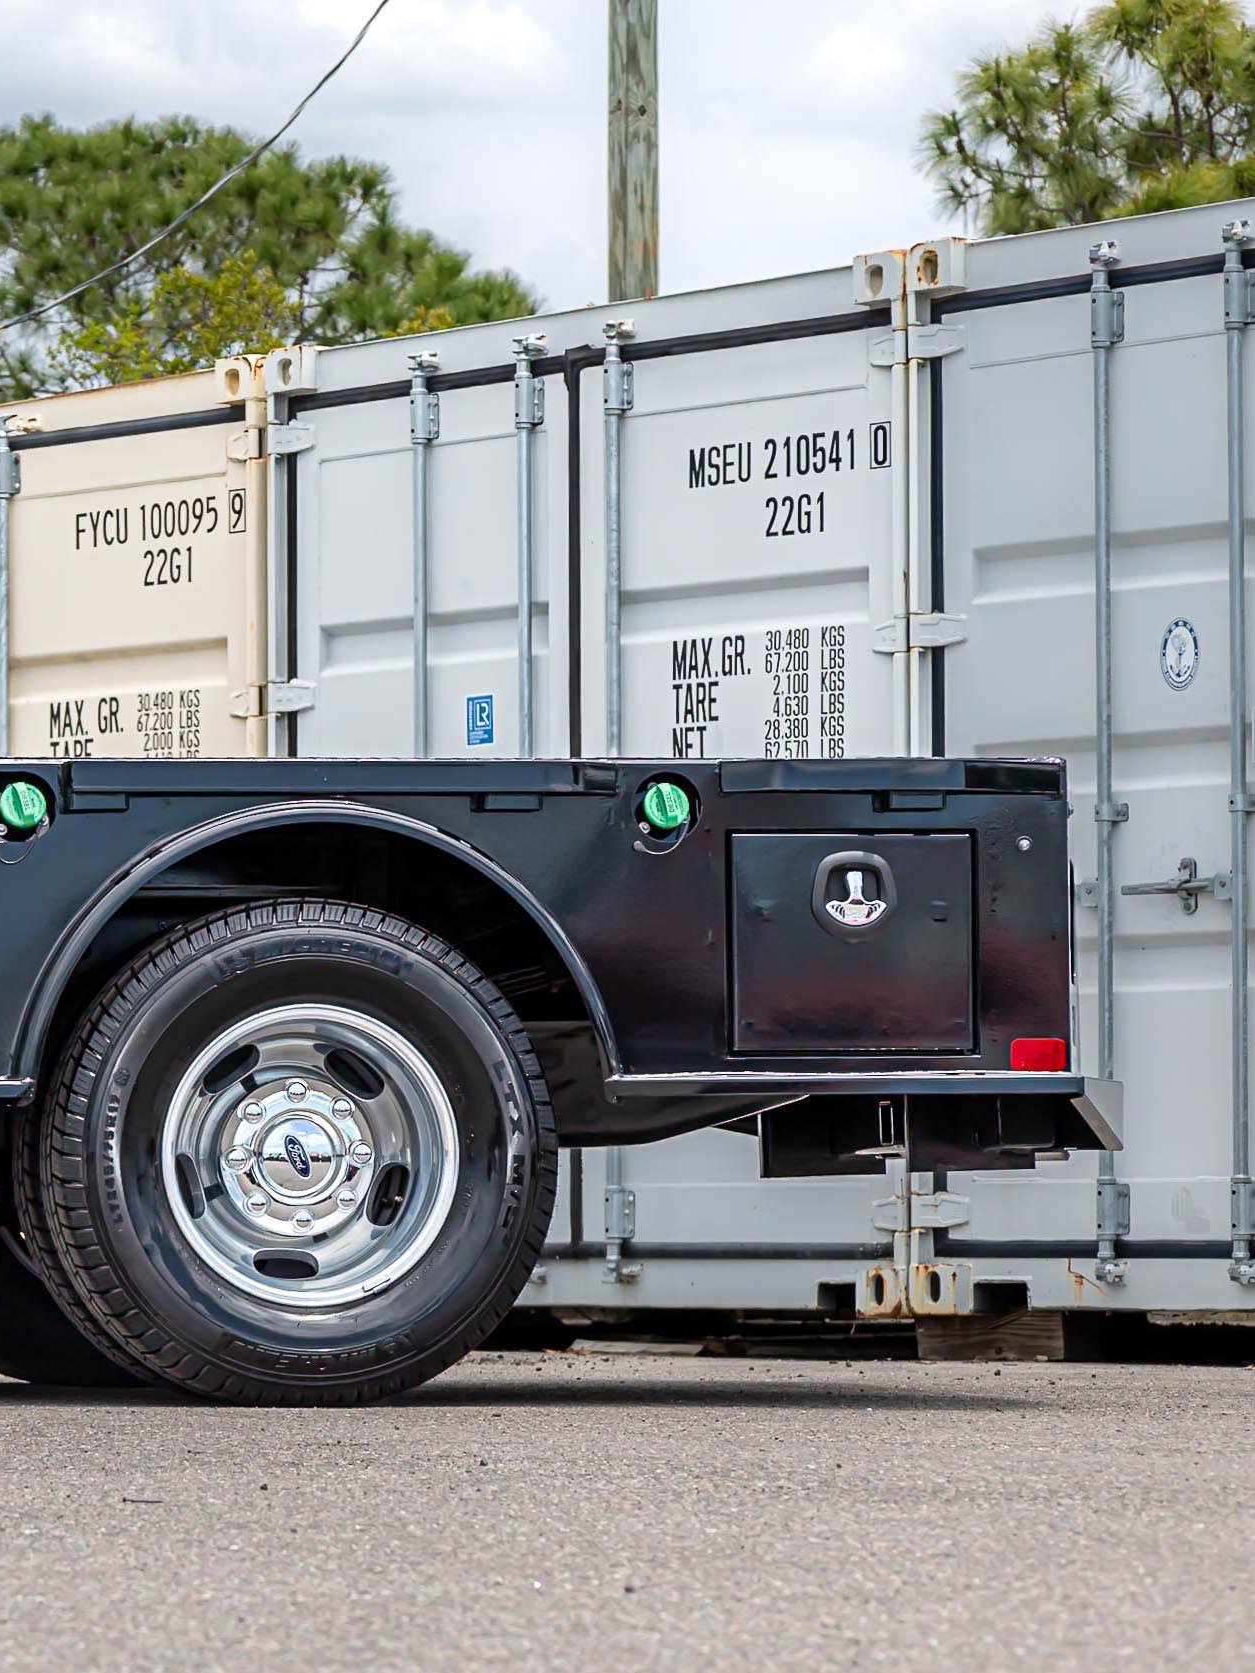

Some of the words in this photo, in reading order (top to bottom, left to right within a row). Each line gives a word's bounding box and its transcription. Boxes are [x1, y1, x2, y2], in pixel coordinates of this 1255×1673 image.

[689, 441, 752, 489] MSEU
[764, 428, 855, 480] 210541
[873, 424, 888, 466] 0
[76, 506, 128, 550] FYCU
[139, 496, 218, 541] 100095
[231, 492, 244, 529] 9
[764, 491, 825, 537] 22G1
[143, 546, 193, 587] 22G1
[765, 628, 809, 651] 30.480
[821, 625, 845, 647] KGS
[765, 650, 809, 673] 67.200
[821, 648, 845, 670] LBS
[50, 699, 88, 739] MAX.
[98, 697, 124, 734] GR.
[179, 689, 200, 709] KGS
[672, 681, 719, 725] TARE
[773, 673, 809, 695] 2.100
[821, 671, 845, 692] KGS
[773, 695, 809, 718] 4.630
[821, 693, 845, 715] LBS
[179, 709, 200, 729] LBS
[179, 729, 200, 749] KGS
[672, 726, 707, 759] NET
[764, 717, 809, 740] 28.380
[821, 715, 845, 737] KGS
[821, 738, 845, 759] LBS
